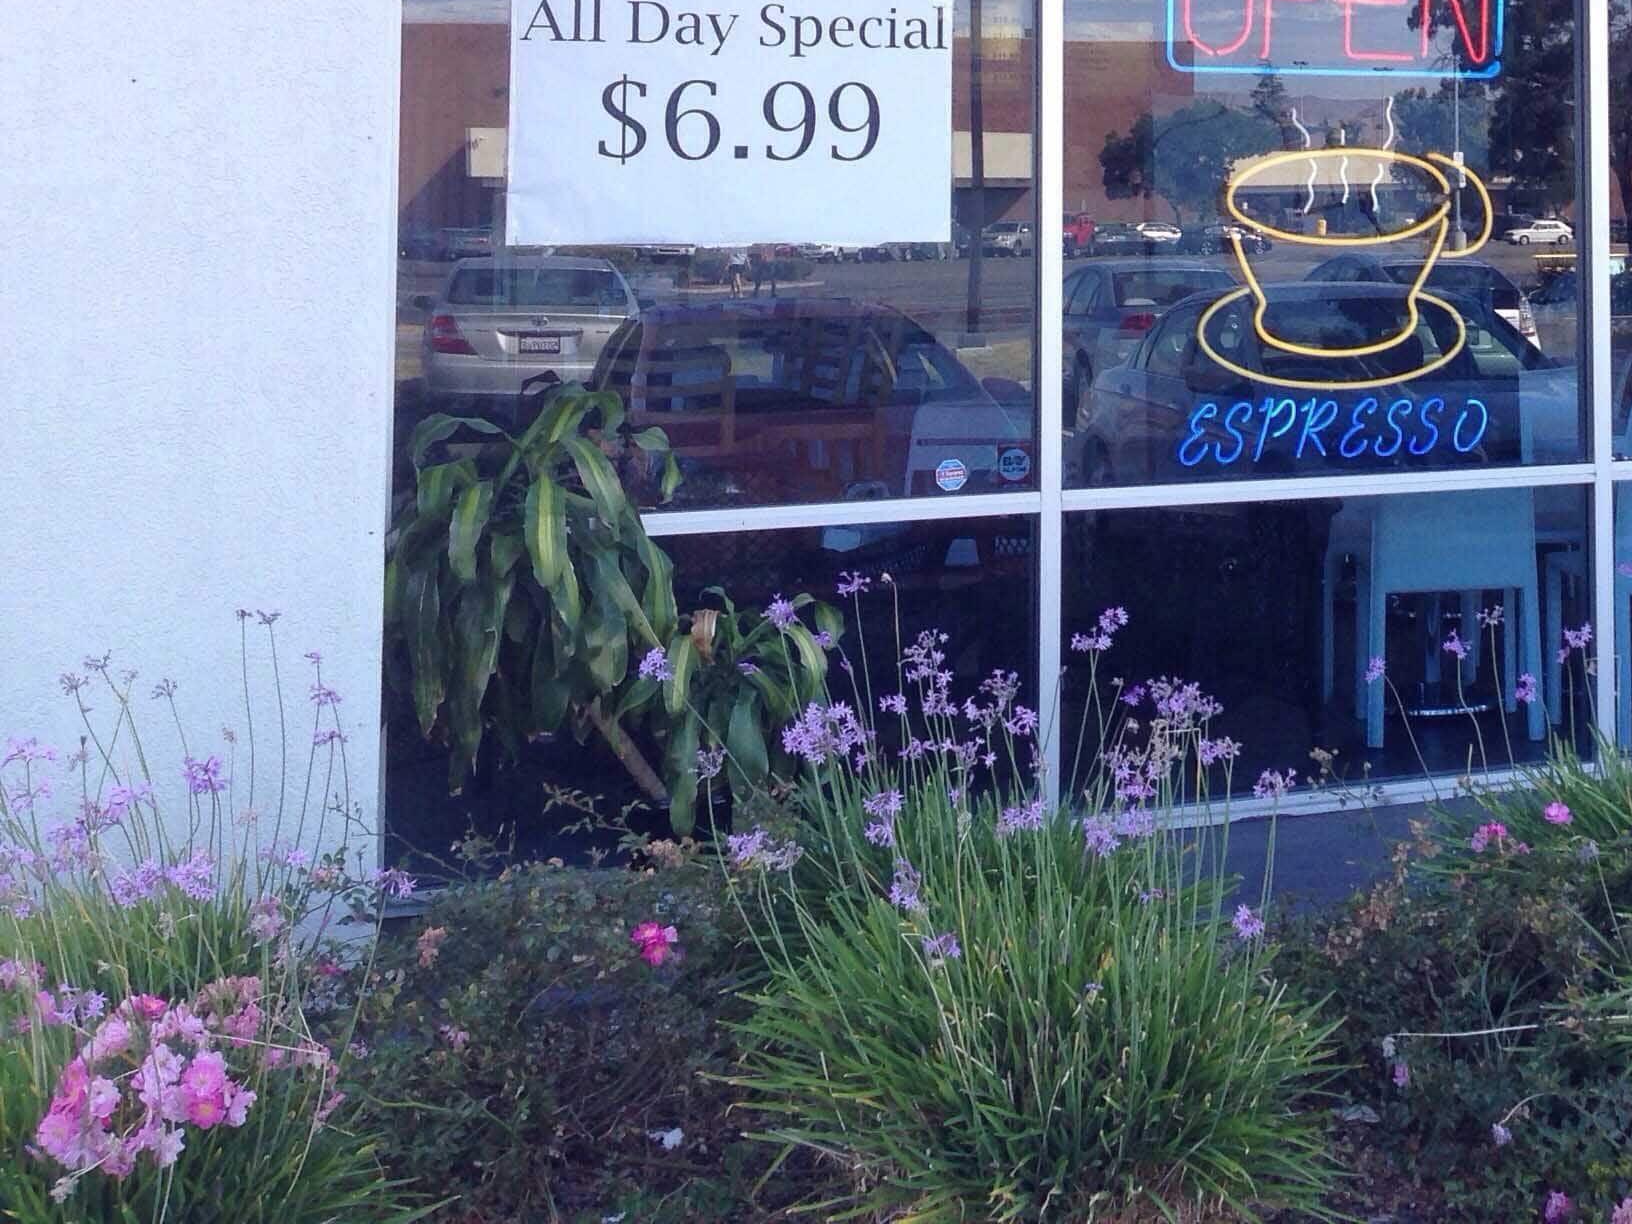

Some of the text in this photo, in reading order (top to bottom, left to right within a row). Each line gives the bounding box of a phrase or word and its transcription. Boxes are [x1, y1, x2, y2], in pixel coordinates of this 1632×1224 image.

[626, 0, 739, 56] Day
[759, 2, 948, 57] Special
[597, 73, 882, 165] $6.99
[1178, 395, 1489, 467] ESPRESSO
